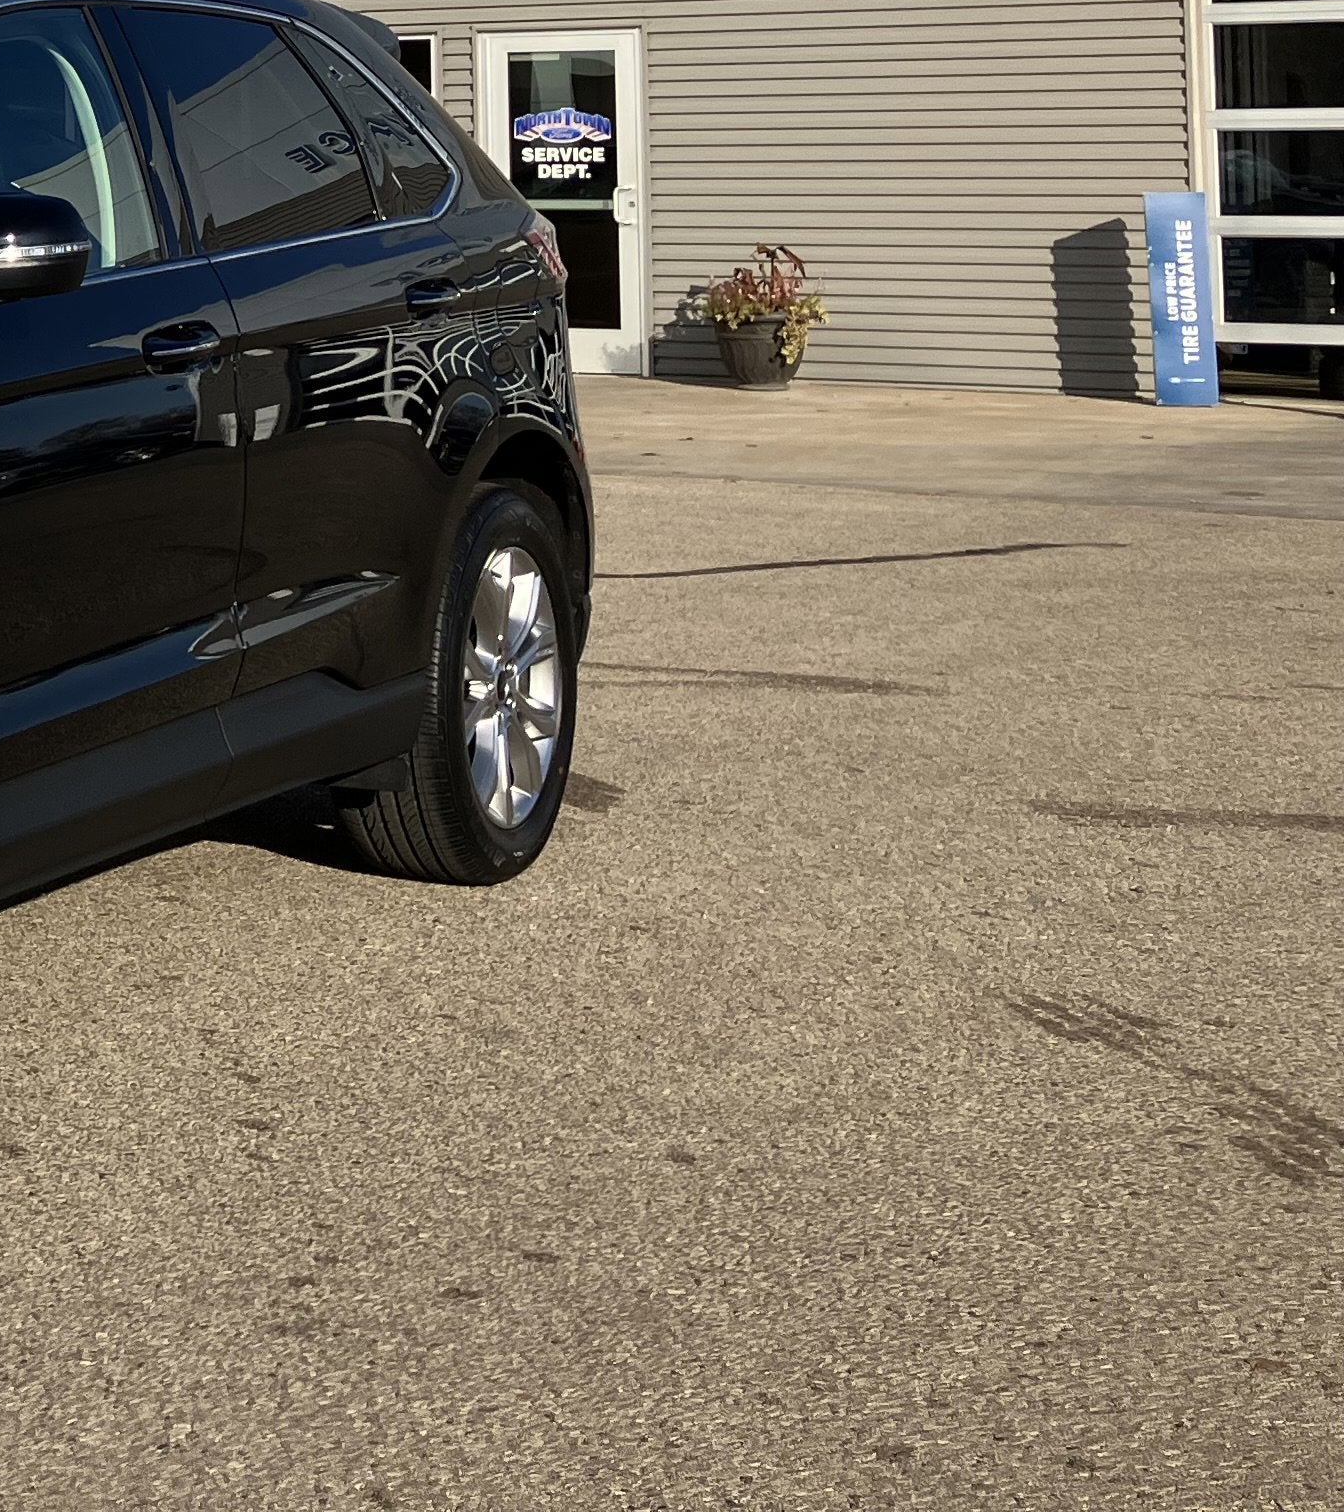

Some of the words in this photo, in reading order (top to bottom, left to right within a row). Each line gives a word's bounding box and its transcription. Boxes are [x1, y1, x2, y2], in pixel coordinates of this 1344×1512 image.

[521, 147, 606, 162] SERVICE
[537, 164, 592, 179] DEPT.
[1164, 261, 1177, 293] PRICE
[1175, 219, 1198, 323] GUARANTEE
[1167, 294, 1180, 322] LOW
[1181, 324, 1200, 365] TIRE
